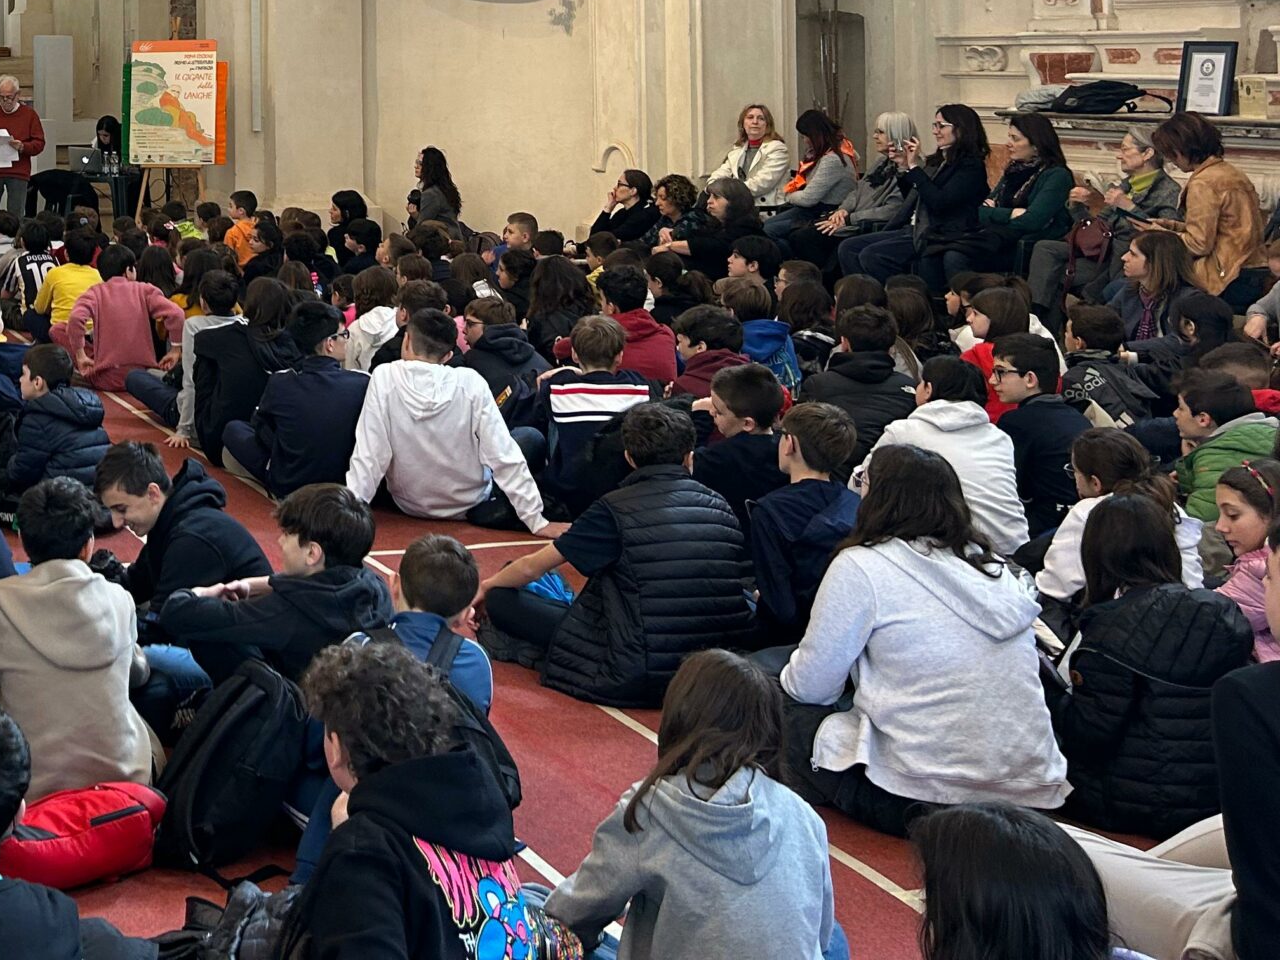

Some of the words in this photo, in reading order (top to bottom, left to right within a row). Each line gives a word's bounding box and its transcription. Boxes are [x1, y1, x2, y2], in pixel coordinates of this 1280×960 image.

[182, 73, 212, 81] GIGANTE
[183, 91, 212, 100] LANGHE
[26, 254, 53, 262] POGBA
